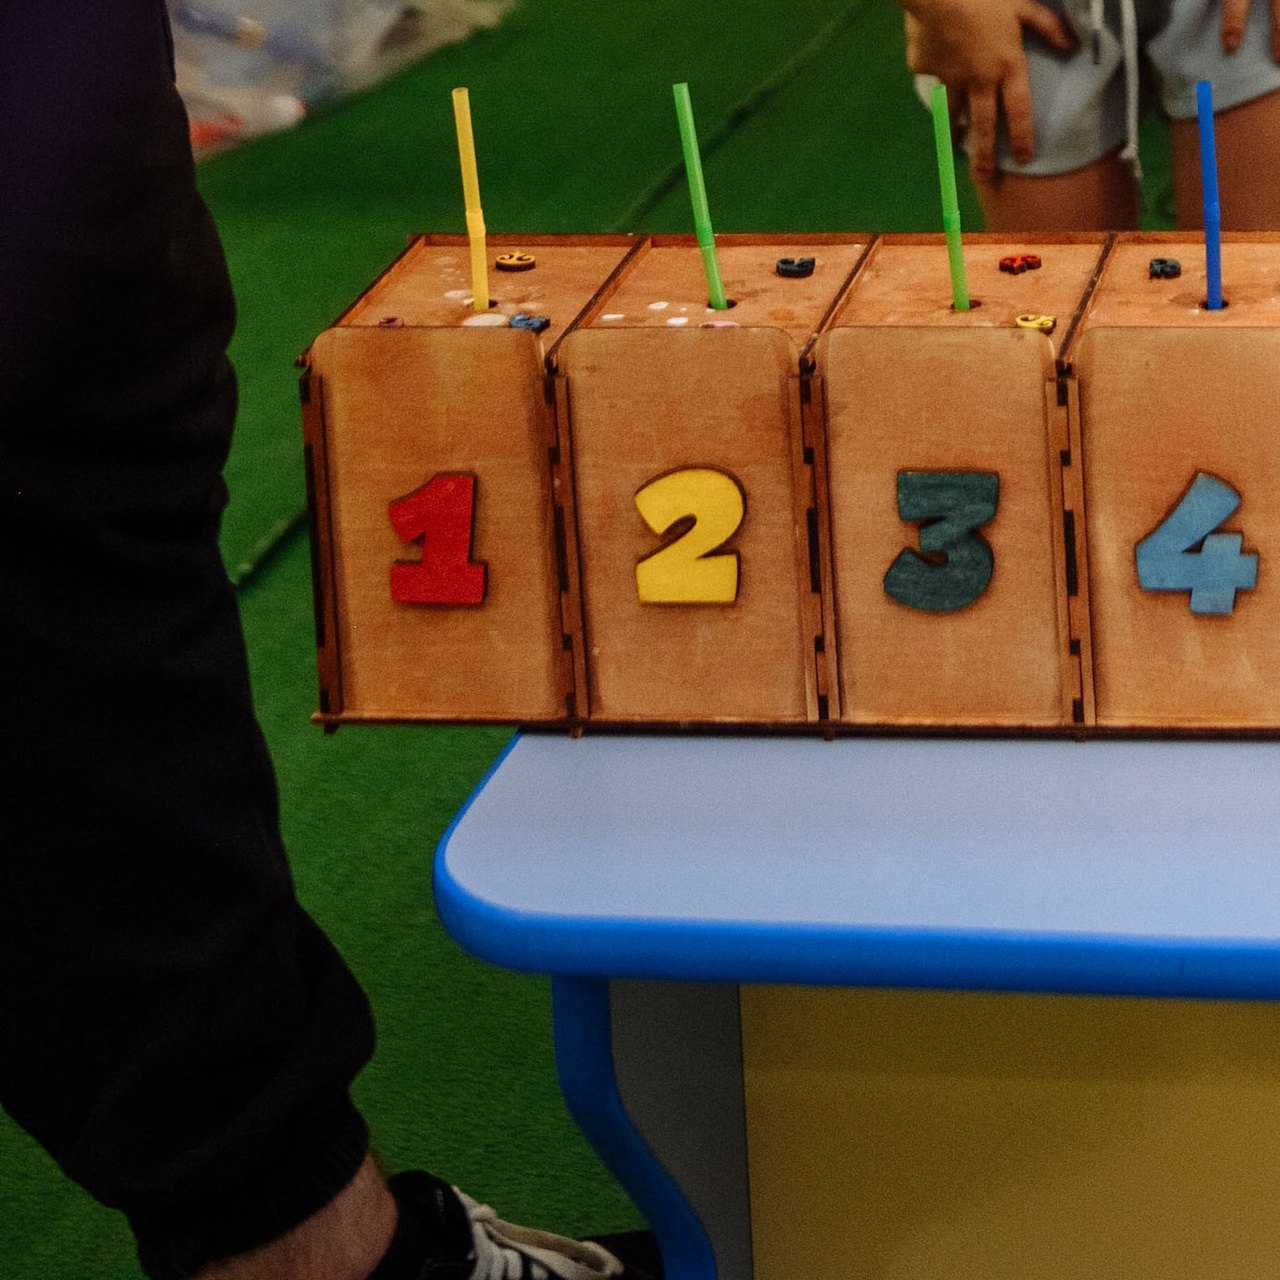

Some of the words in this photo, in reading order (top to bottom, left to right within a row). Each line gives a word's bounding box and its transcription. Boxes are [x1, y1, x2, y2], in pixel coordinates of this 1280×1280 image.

[388, 471, 488, 605] 1
[635, 464, 746, 604] 2
[883, 470, 999, 613] 3
[1135, 471, 1259, 616] 4
